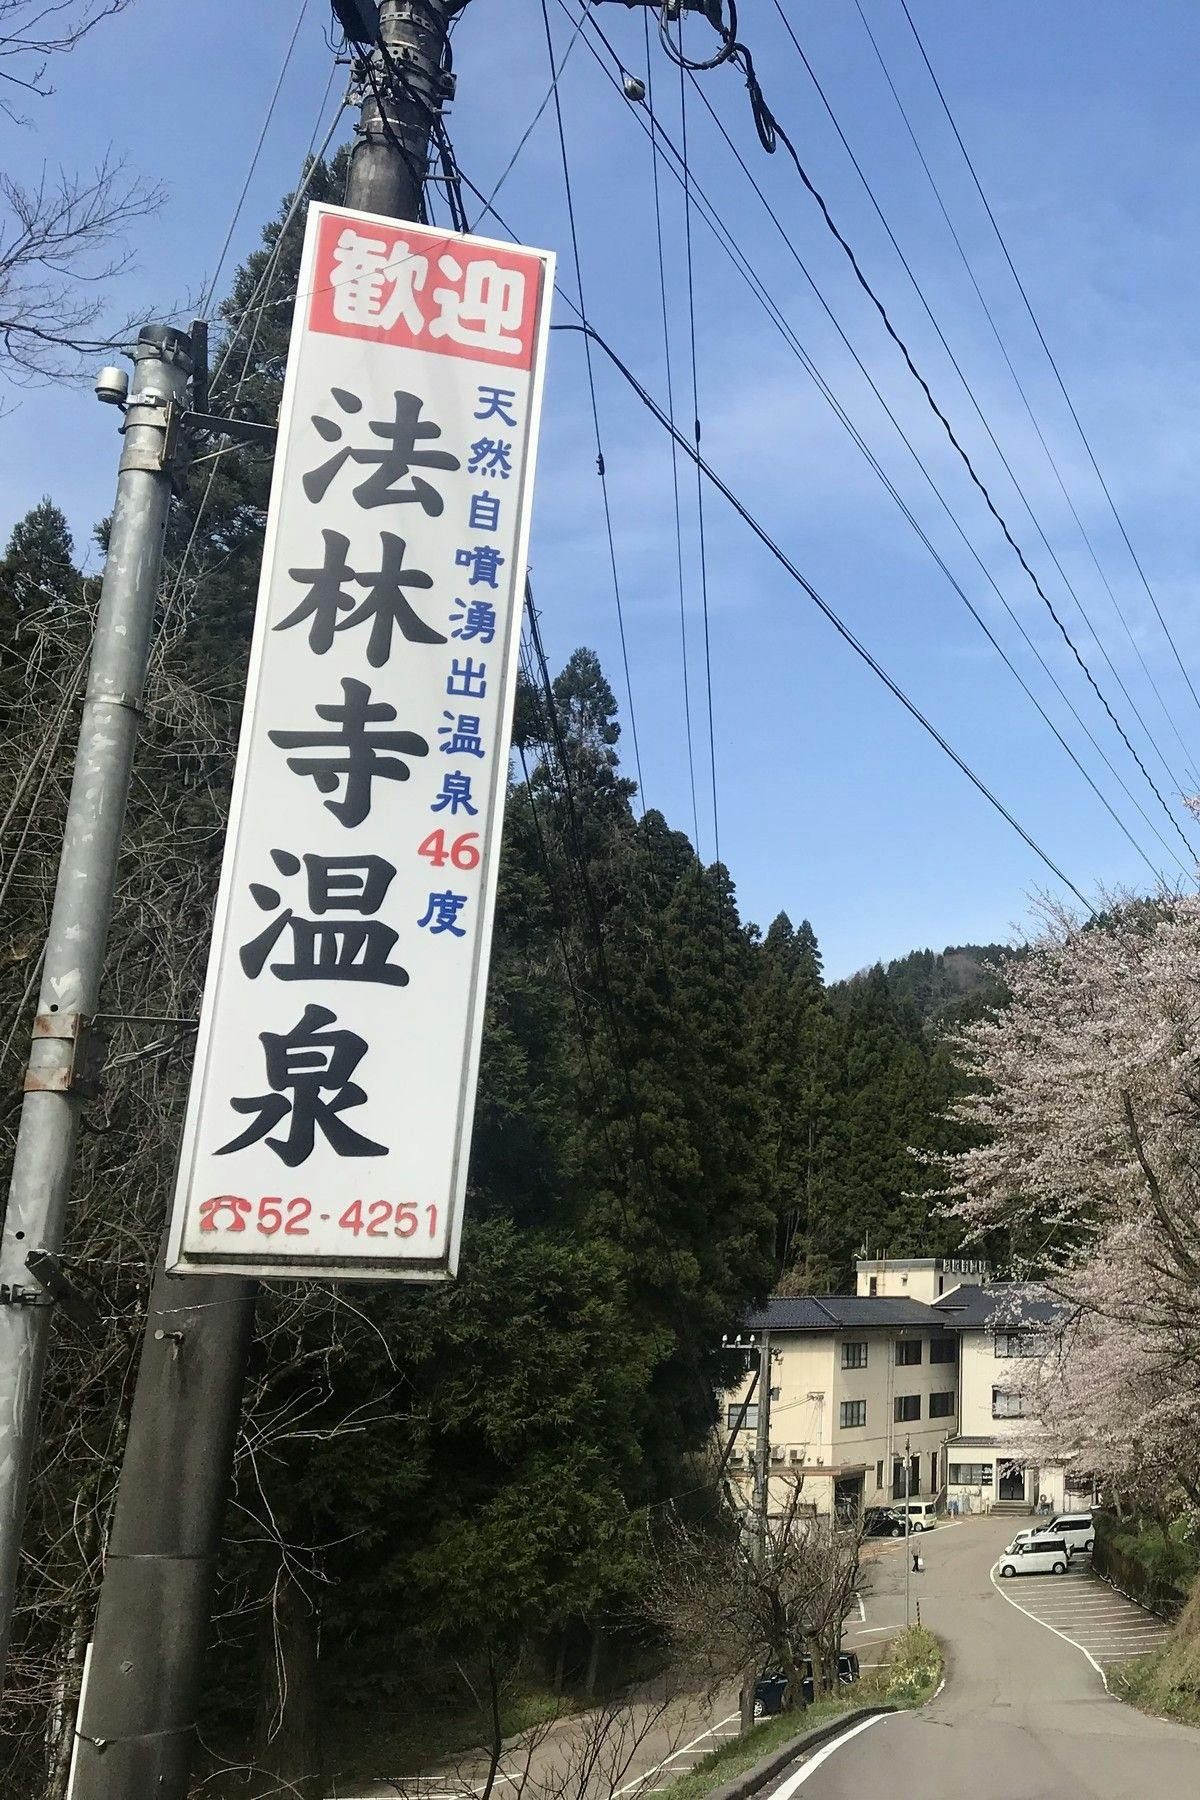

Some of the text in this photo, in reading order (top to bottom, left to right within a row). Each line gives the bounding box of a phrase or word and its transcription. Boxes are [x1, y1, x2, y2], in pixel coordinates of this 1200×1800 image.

[330, 229, 525, 356] 歓迎
[211, 387, 461, 1167] 法林寺温泉
